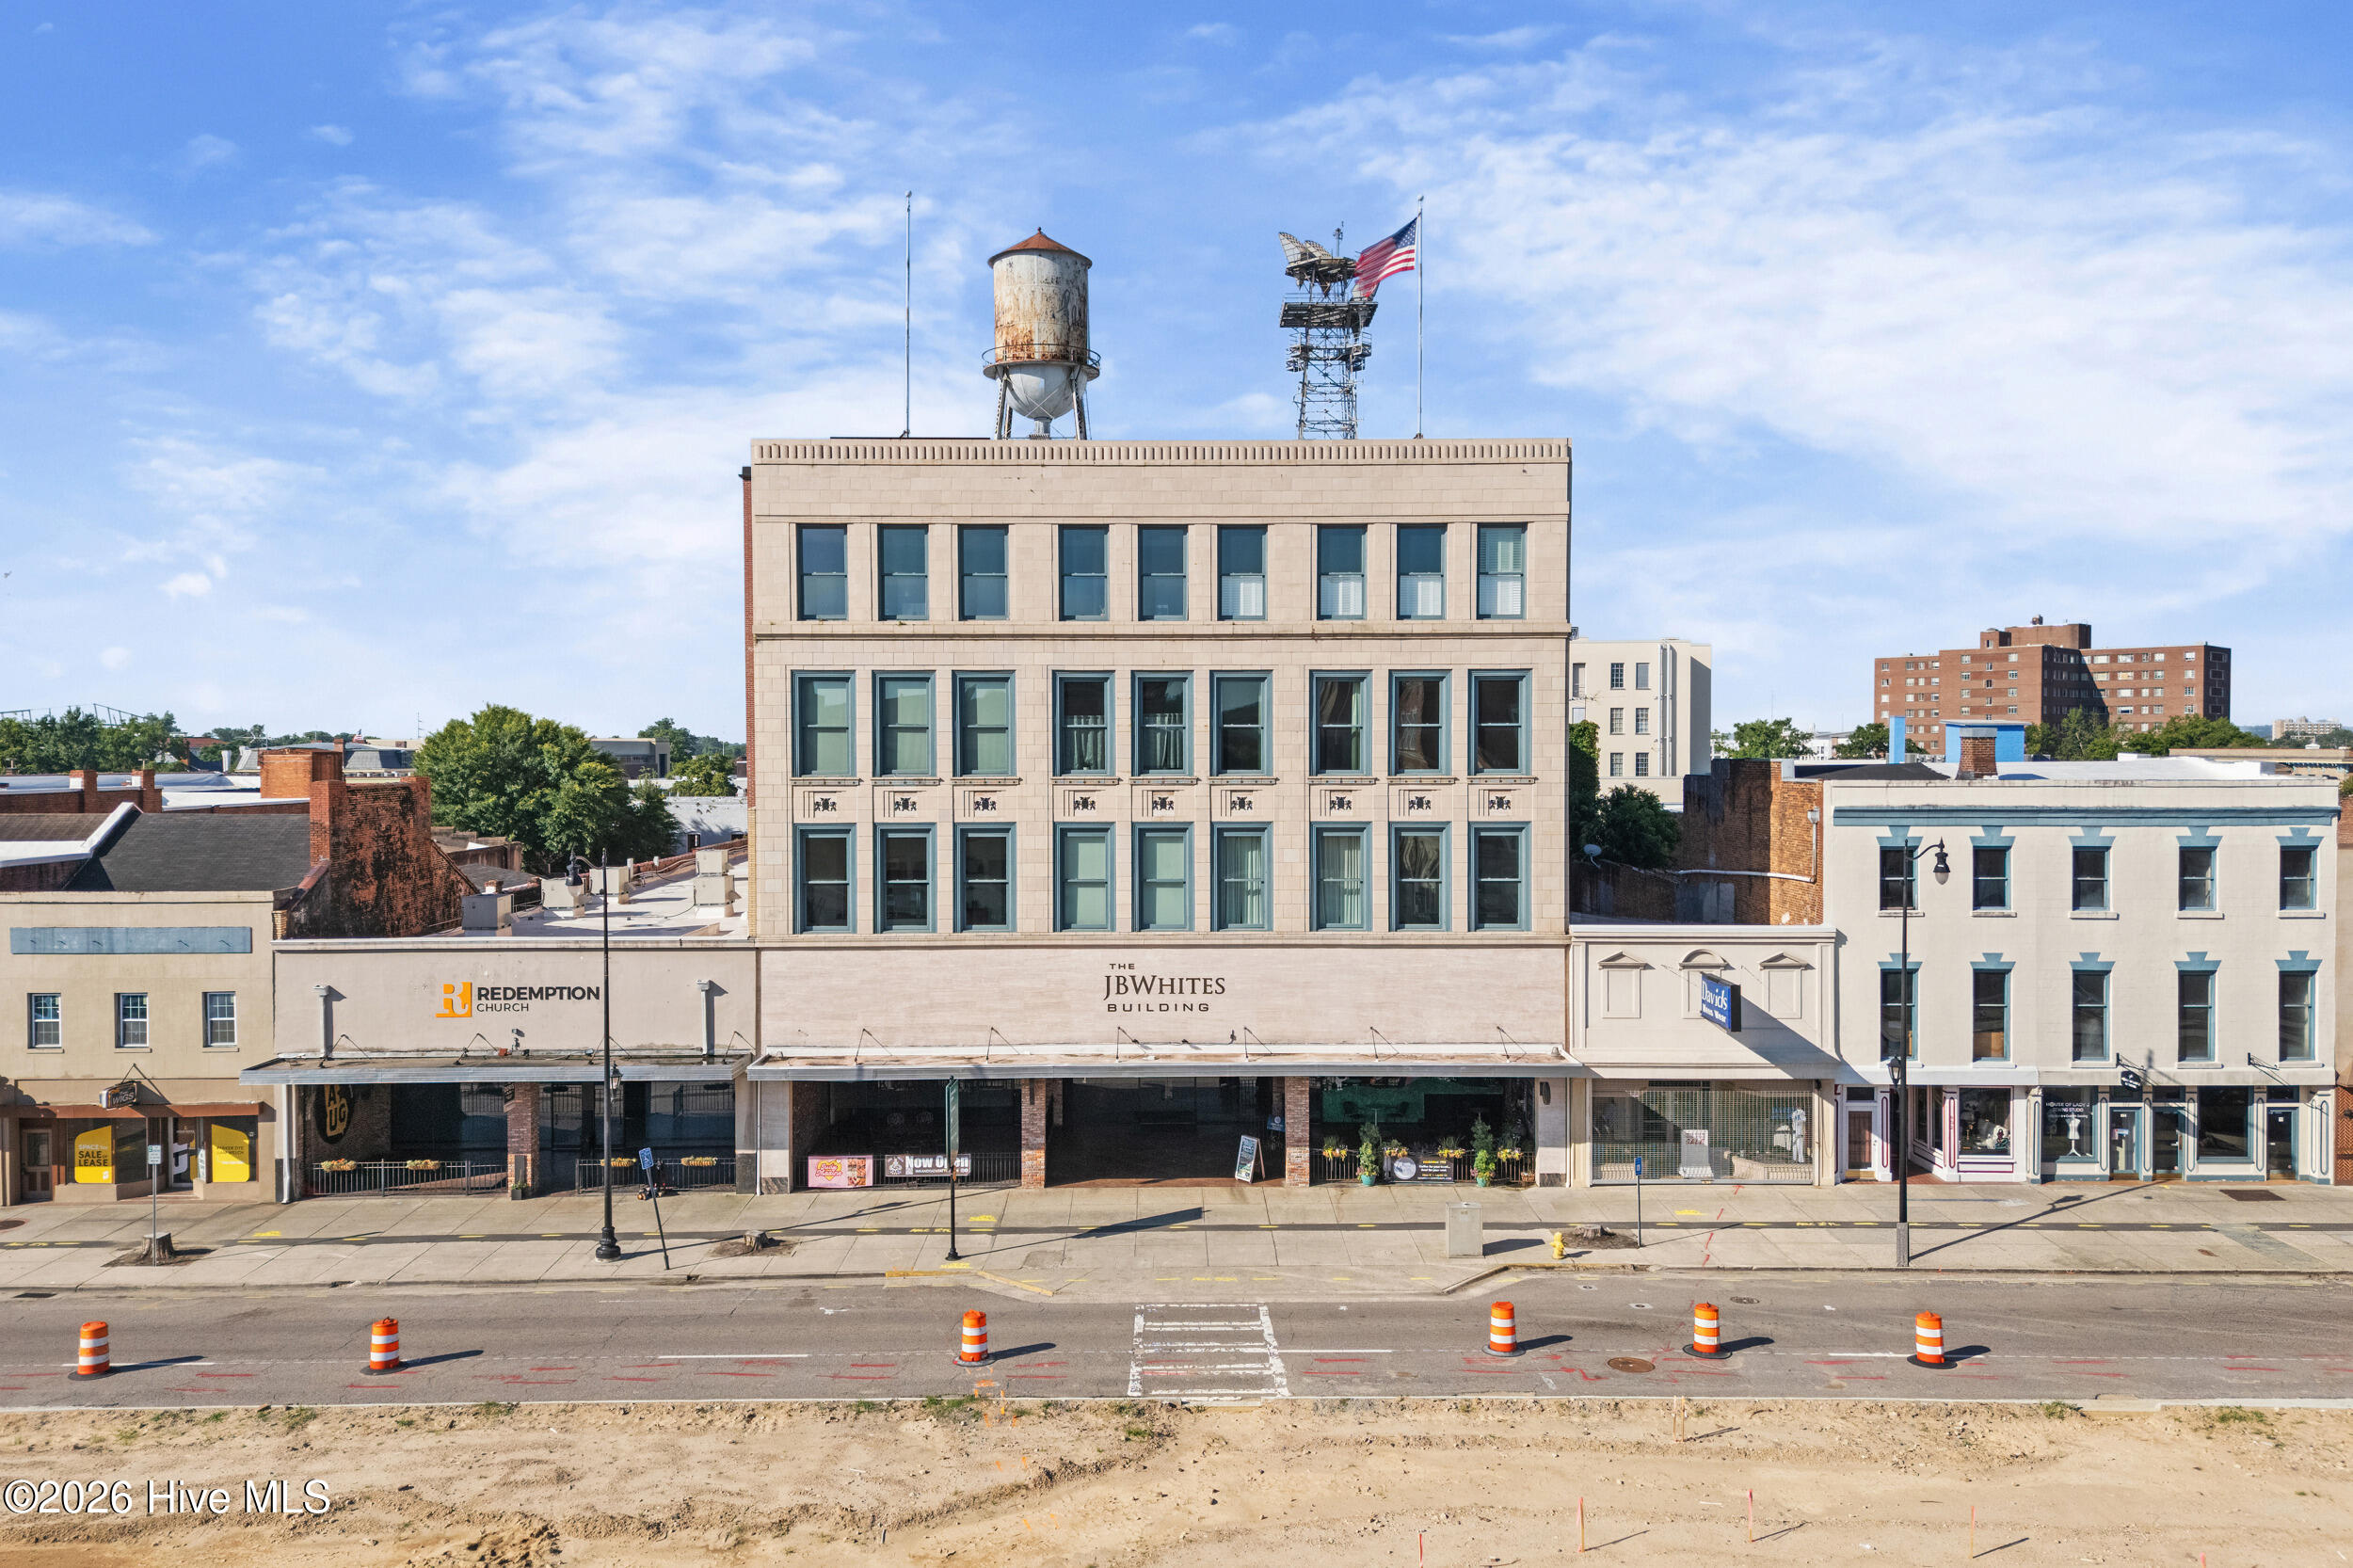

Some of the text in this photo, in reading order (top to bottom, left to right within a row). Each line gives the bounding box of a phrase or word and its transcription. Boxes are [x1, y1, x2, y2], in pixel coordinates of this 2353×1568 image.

[477, 986, 600, 1001] REDEMPTION
[476, 1002, 529, 1013] CHURCH
[1107, 1003, 1209, 1013] BUILDING
[113, 1092, 135, 1105] WIGS
[78, 1150, 103, 1159] SALE
[78, 1159, 108, 1167] LEASE
[904, 1155, 934, 1169] Now
